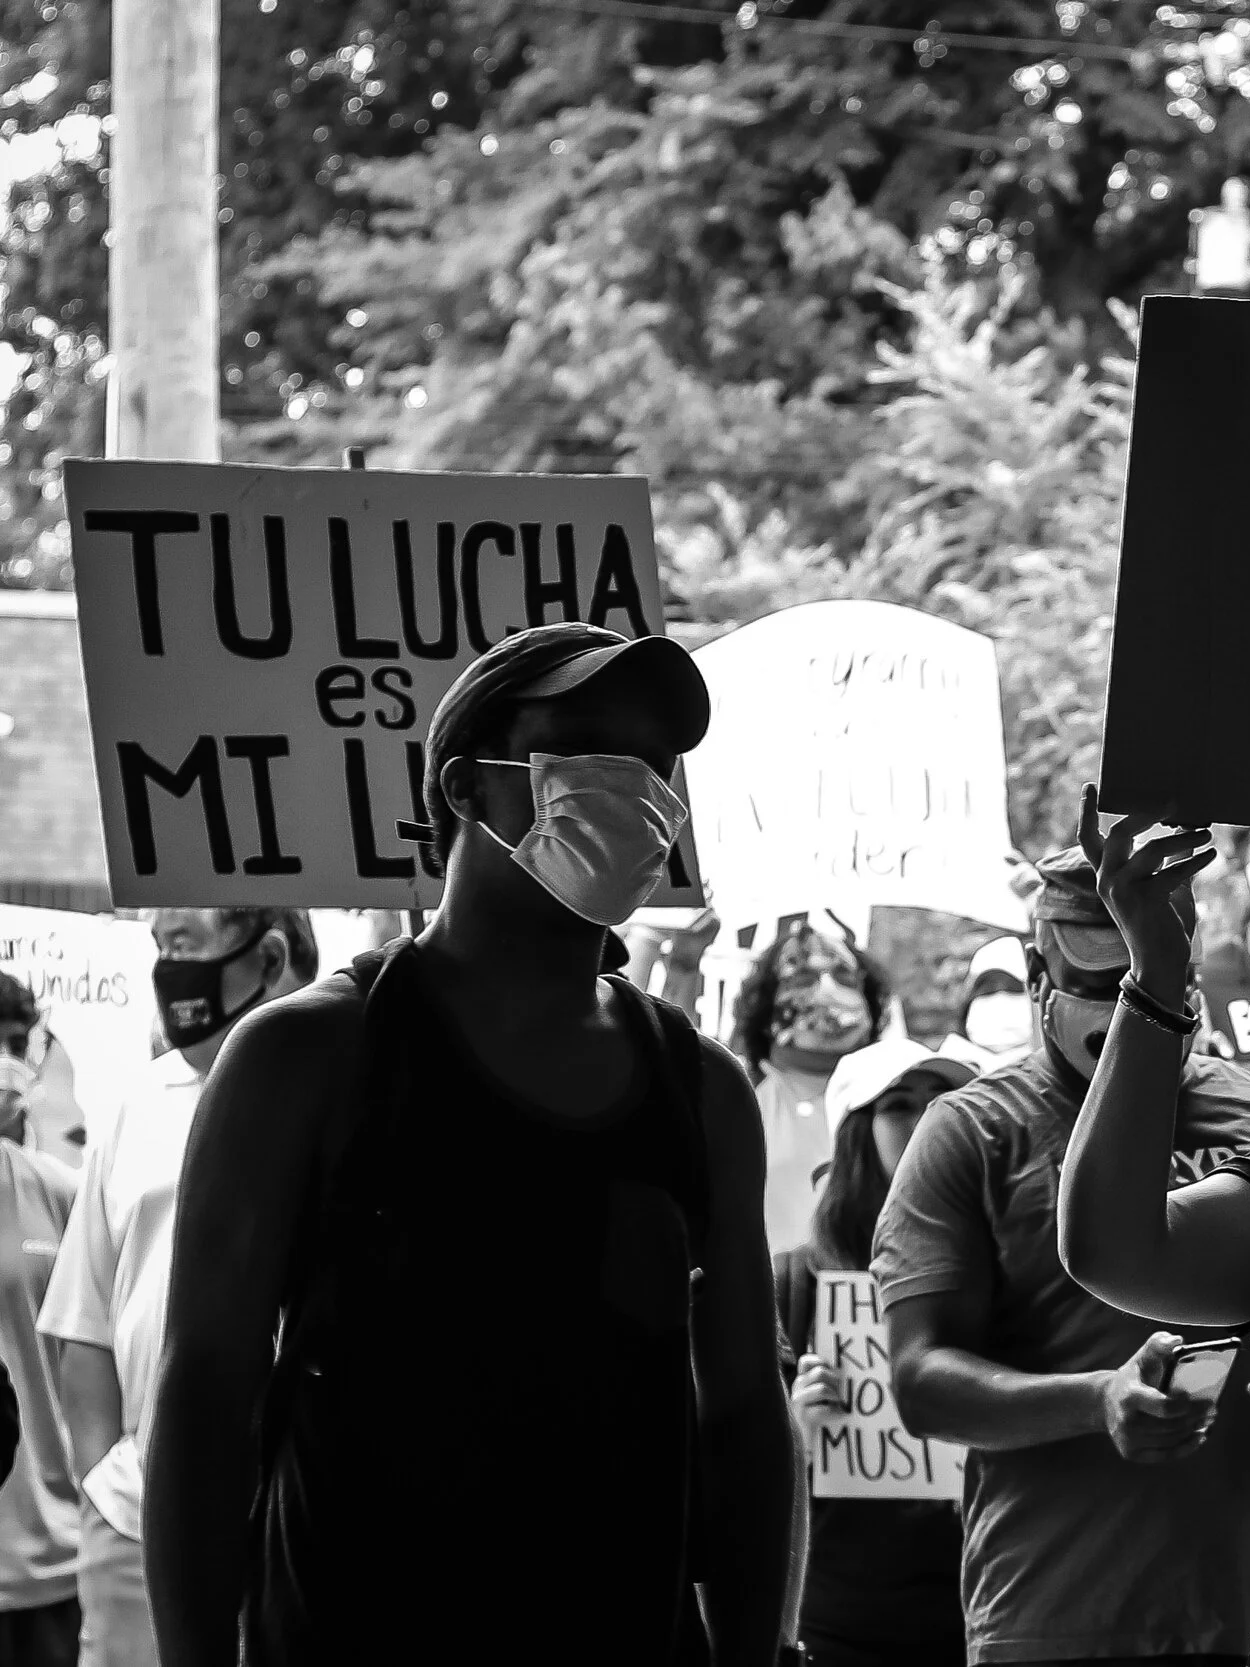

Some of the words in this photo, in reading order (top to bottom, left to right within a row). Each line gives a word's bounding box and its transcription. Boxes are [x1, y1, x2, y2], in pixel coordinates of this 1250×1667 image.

[84, 508, 293, 661] TU
[327, 515, 651, 661] LUCHA
[314, 663, 417, 731] es
[115, 734, 303, 878] MI
